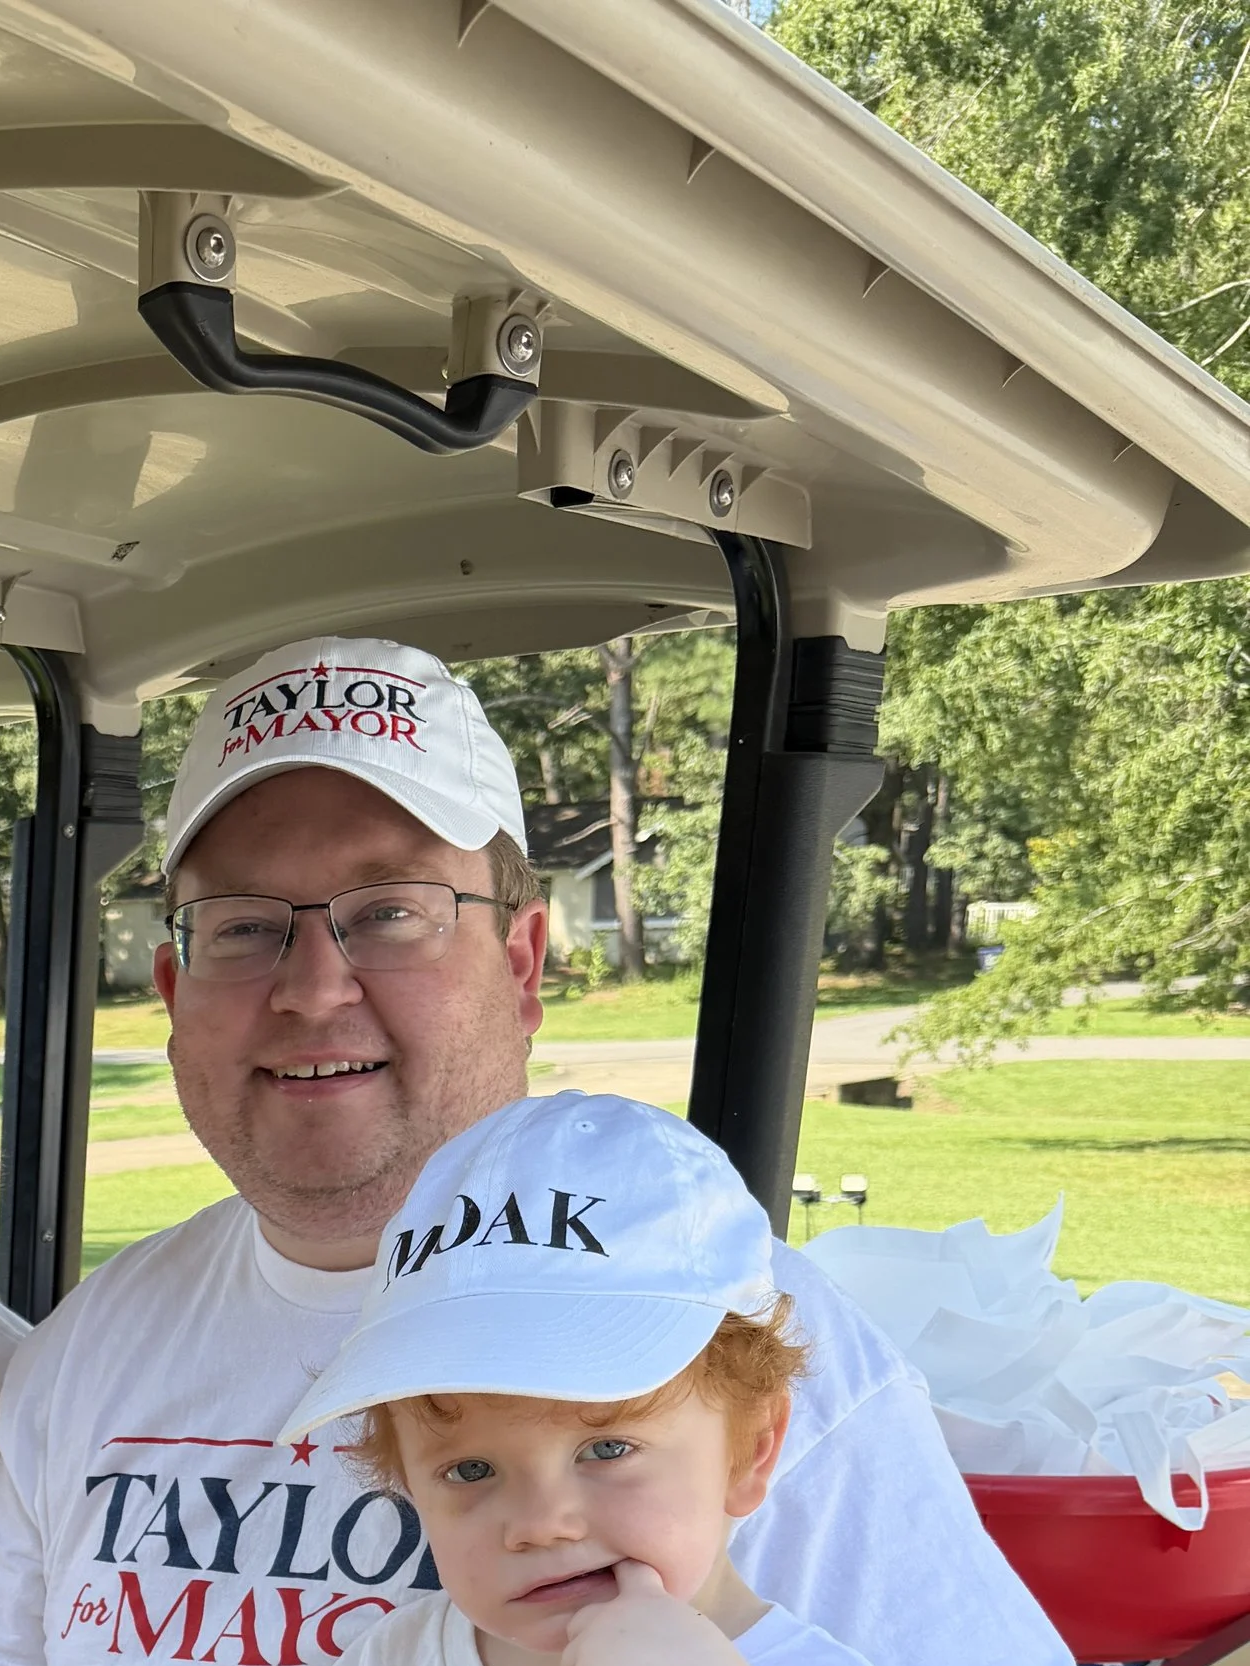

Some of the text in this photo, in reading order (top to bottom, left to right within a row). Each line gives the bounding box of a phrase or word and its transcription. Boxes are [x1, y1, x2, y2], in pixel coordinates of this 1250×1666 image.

[217, 709, 428, 767] for MAYOR
[224, 680, 428, 732] TAYLOR
[382, 1187, 610, 1294] MOAK
[85, 1472, 444, 1591] TAYLO
[61, 1571, 397, 1666] for MAYO
